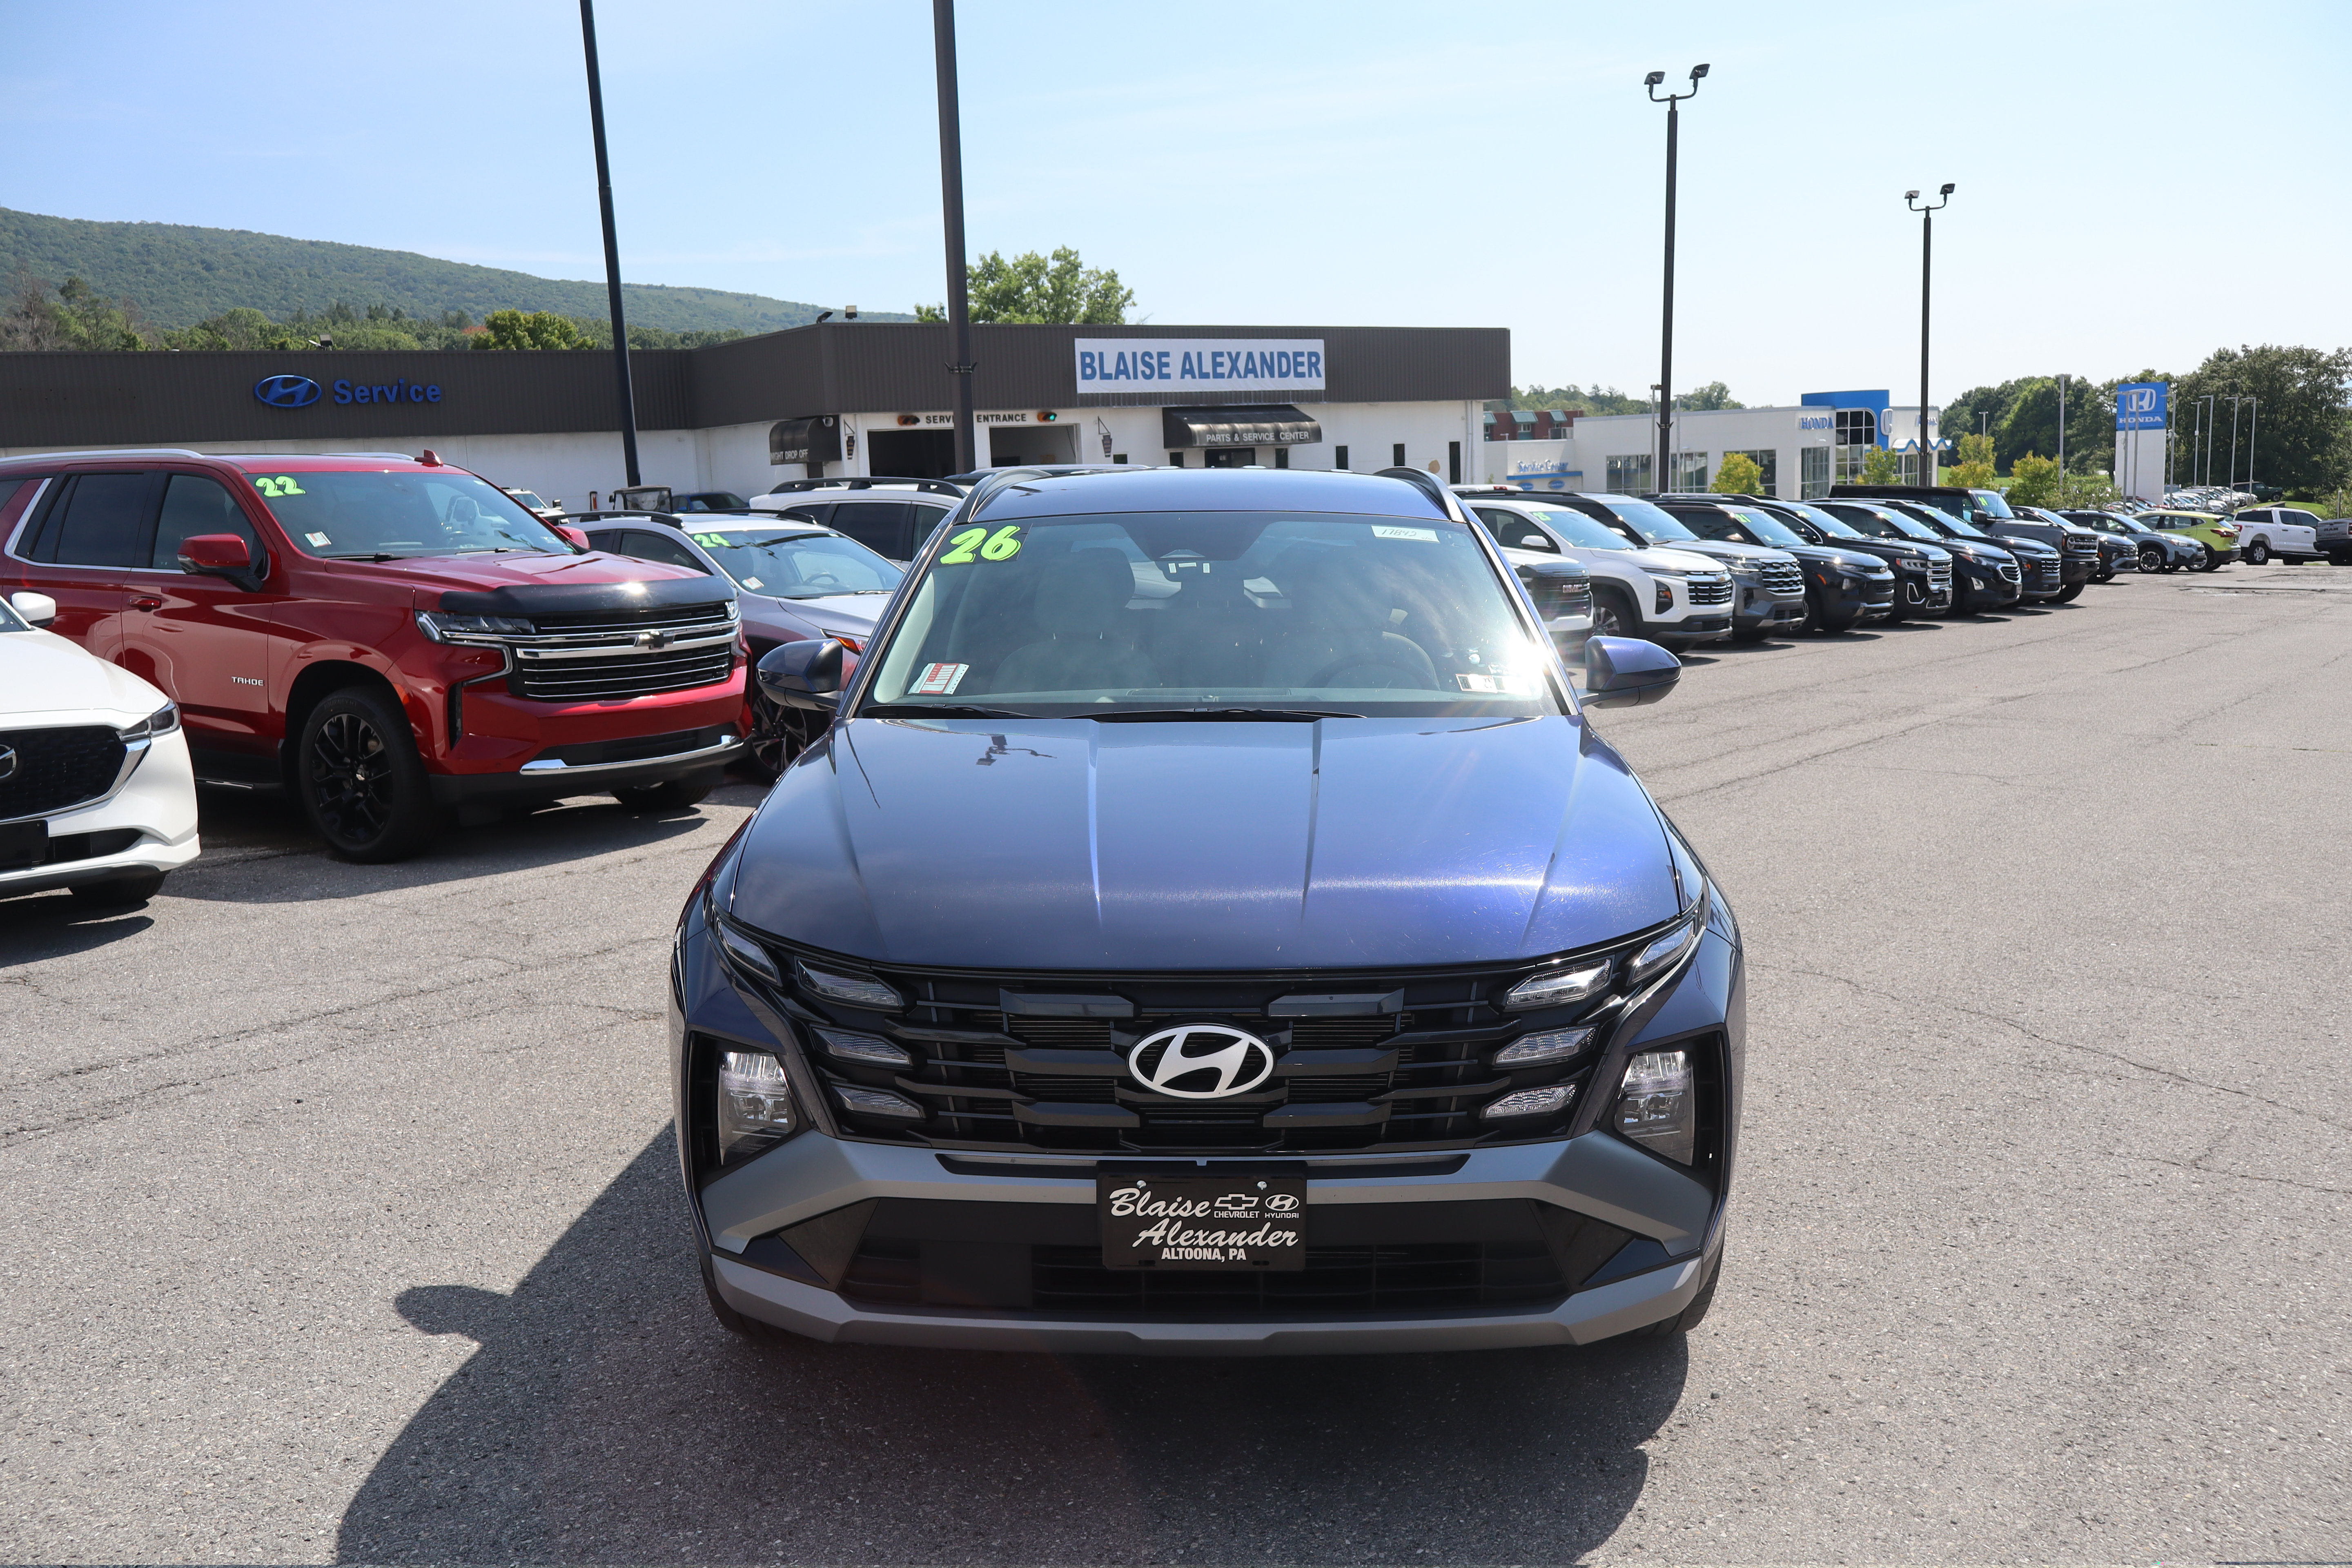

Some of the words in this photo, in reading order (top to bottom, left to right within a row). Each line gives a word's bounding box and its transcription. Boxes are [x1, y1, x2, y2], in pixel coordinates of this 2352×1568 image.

[1080, 351, 1171, 380] BLAISE
[1180, 351, 1322, 379] ALEXANDER
[333, 379, 441, 404] Service
[926, 415, 954, 424] SERVI
[977, 414, 1027, 423] ENTRANCE
[1801, 417, 1834, 429] HONDA
[1206, 434, 1231, 442] PARTS
[1234, 433, 1239, 441] &
[1243, 432, 1275, 441] SERVICE
[1280, 431, 1309, 440] CENTER
[771, 451, 784, 460] NIGHT
[785, 450, 797, 459] DROP
[799, 449, 808, 458] OFF
[1517, 460, 1544, 473] Service
[255, 476, 306, 497] 22
[693, 533, 731, 548] 24
[940, 525, 1022, 564] 26
[1563, 584, 1582, 593] GMC
[231, 676, 264, 686] TAHOE
[1109, 1187, 1211, 1218] Blaise
[1132, 1218, 1298, 1247] Alexander
[1161, 1247, 1225, 1262] ALTOONA,
[1229, 1248, 1247, 1260] PA
